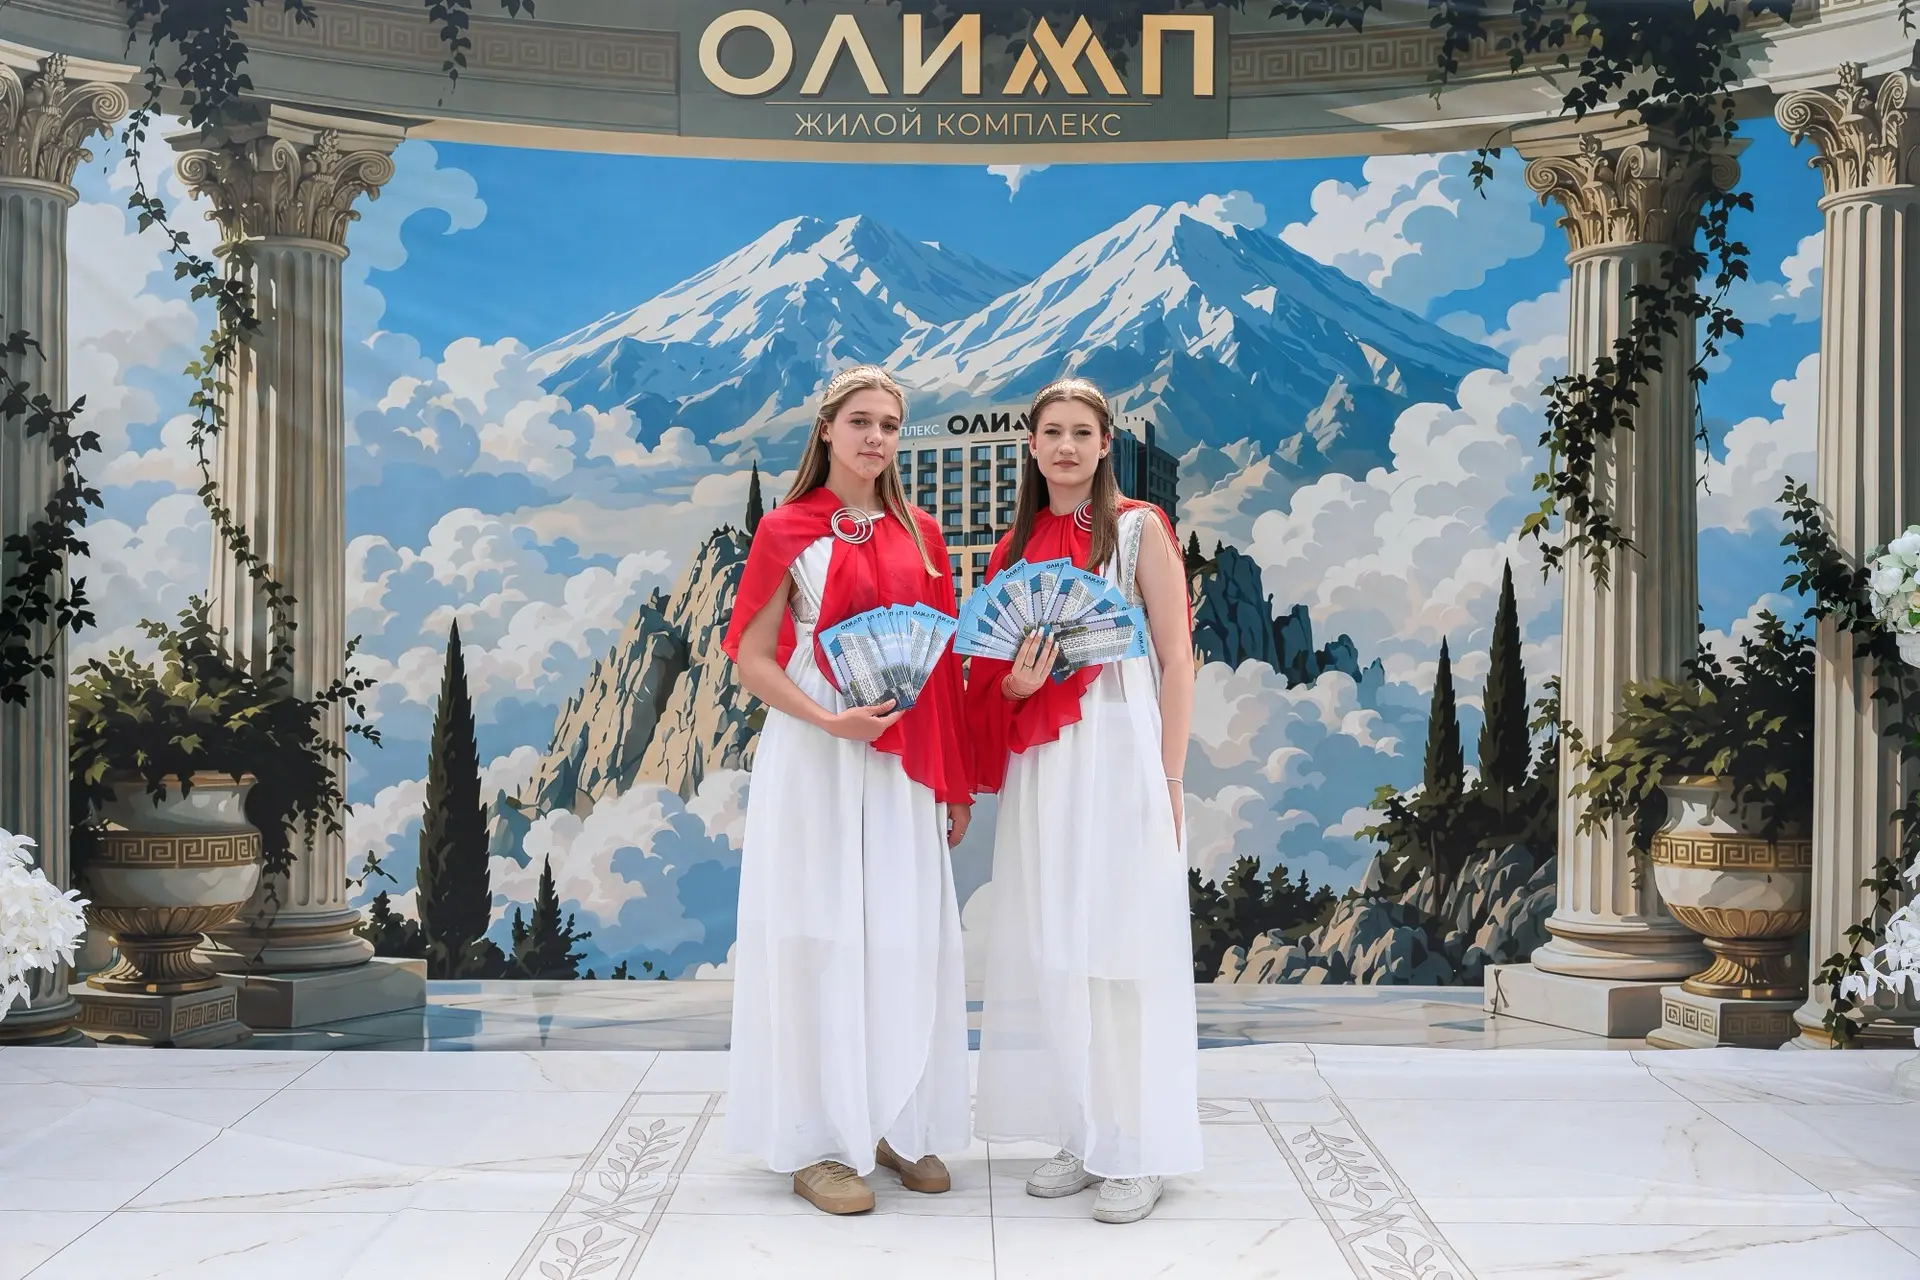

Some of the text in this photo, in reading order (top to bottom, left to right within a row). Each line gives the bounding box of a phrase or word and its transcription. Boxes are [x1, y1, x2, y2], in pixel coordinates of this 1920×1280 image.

[698, 9, 1214, 96] ОЛИМП
[794, 107, 1122, 136] ЖИЛОЙ КОМПЛЕКС
